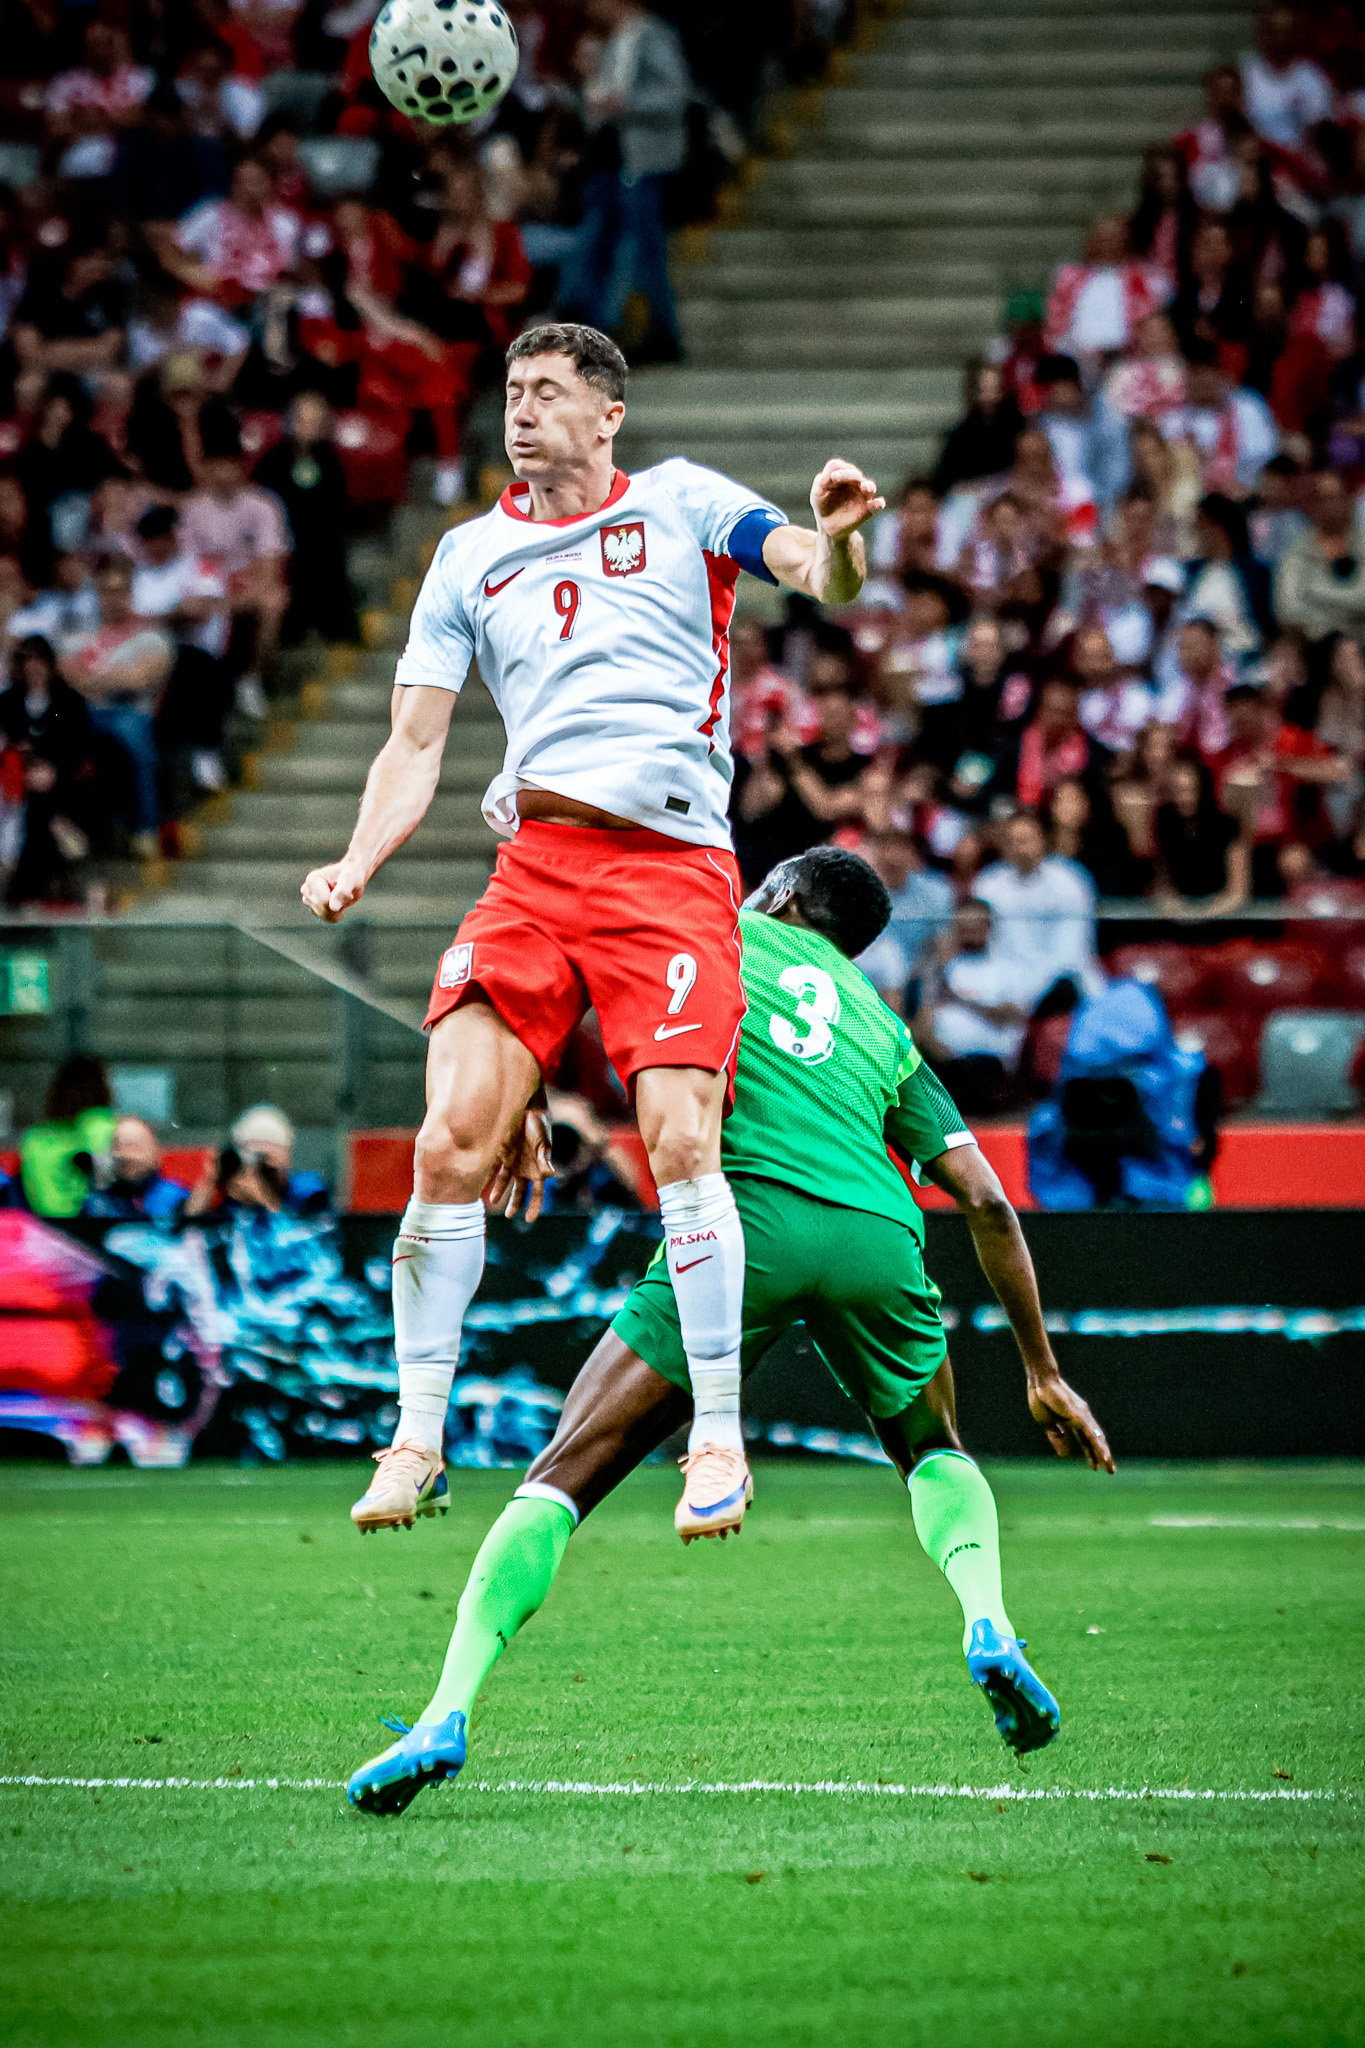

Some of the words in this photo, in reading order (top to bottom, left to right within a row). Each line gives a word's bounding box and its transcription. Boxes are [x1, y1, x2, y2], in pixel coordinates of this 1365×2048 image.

[553, 580, 581, 641] 9
[666, 953, 697, 1014] 9
[769, 965, 840, 1066] 3
[670, 1230, 718, 1249] POLSKA
